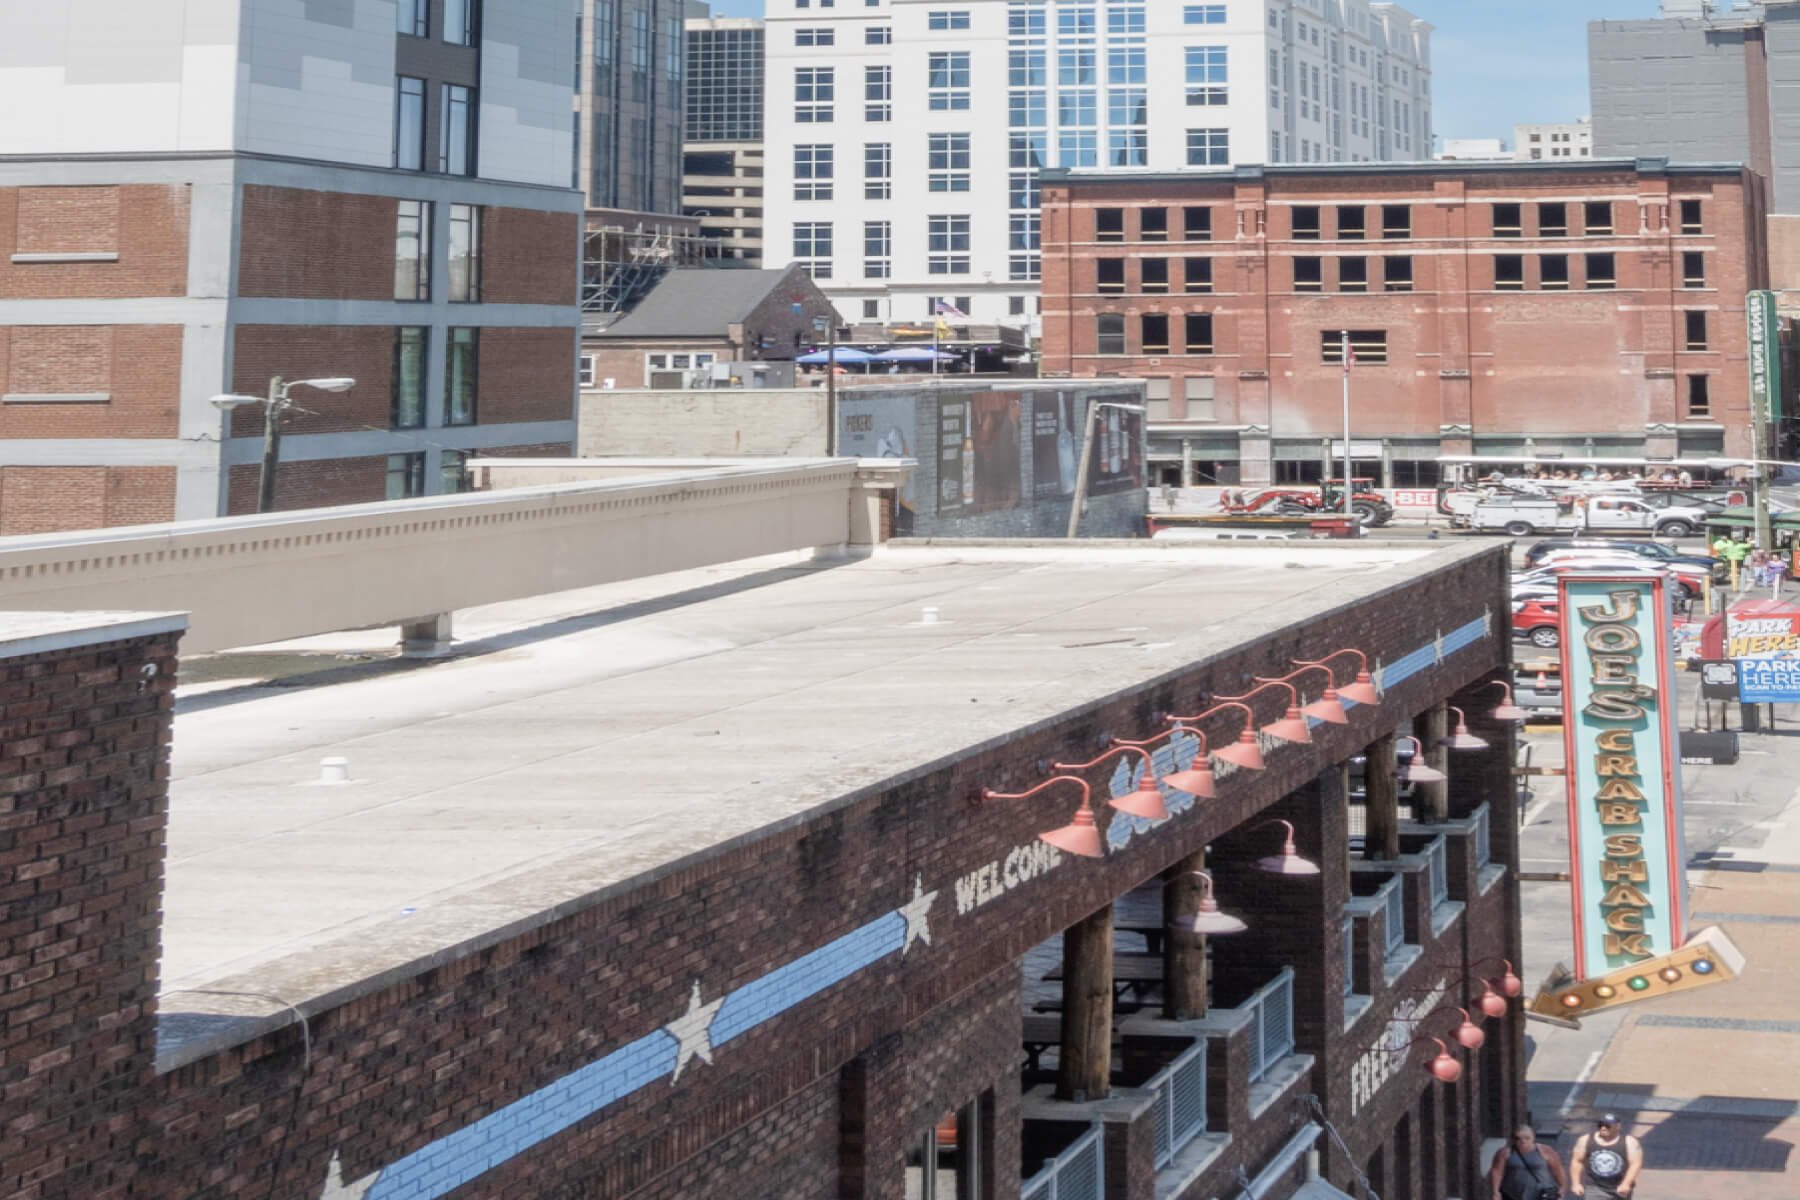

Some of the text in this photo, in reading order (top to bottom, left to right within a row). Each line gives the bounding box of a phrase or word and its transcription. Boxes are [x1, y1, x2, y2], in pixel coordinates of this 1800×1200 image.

[1731, 618, 1793, 636] PARK
[1729, 633, 1800, 657] HERE
[1742, 660, 1800, 672] PARK
[1742, 672, 1800, 684] HERE
[1578, 590, 1657, 957] JOE'S CRAB SHACK
[954, 839, 1062, 915] WELCOME
[1351, 1031, 1390, 1117] FREE
